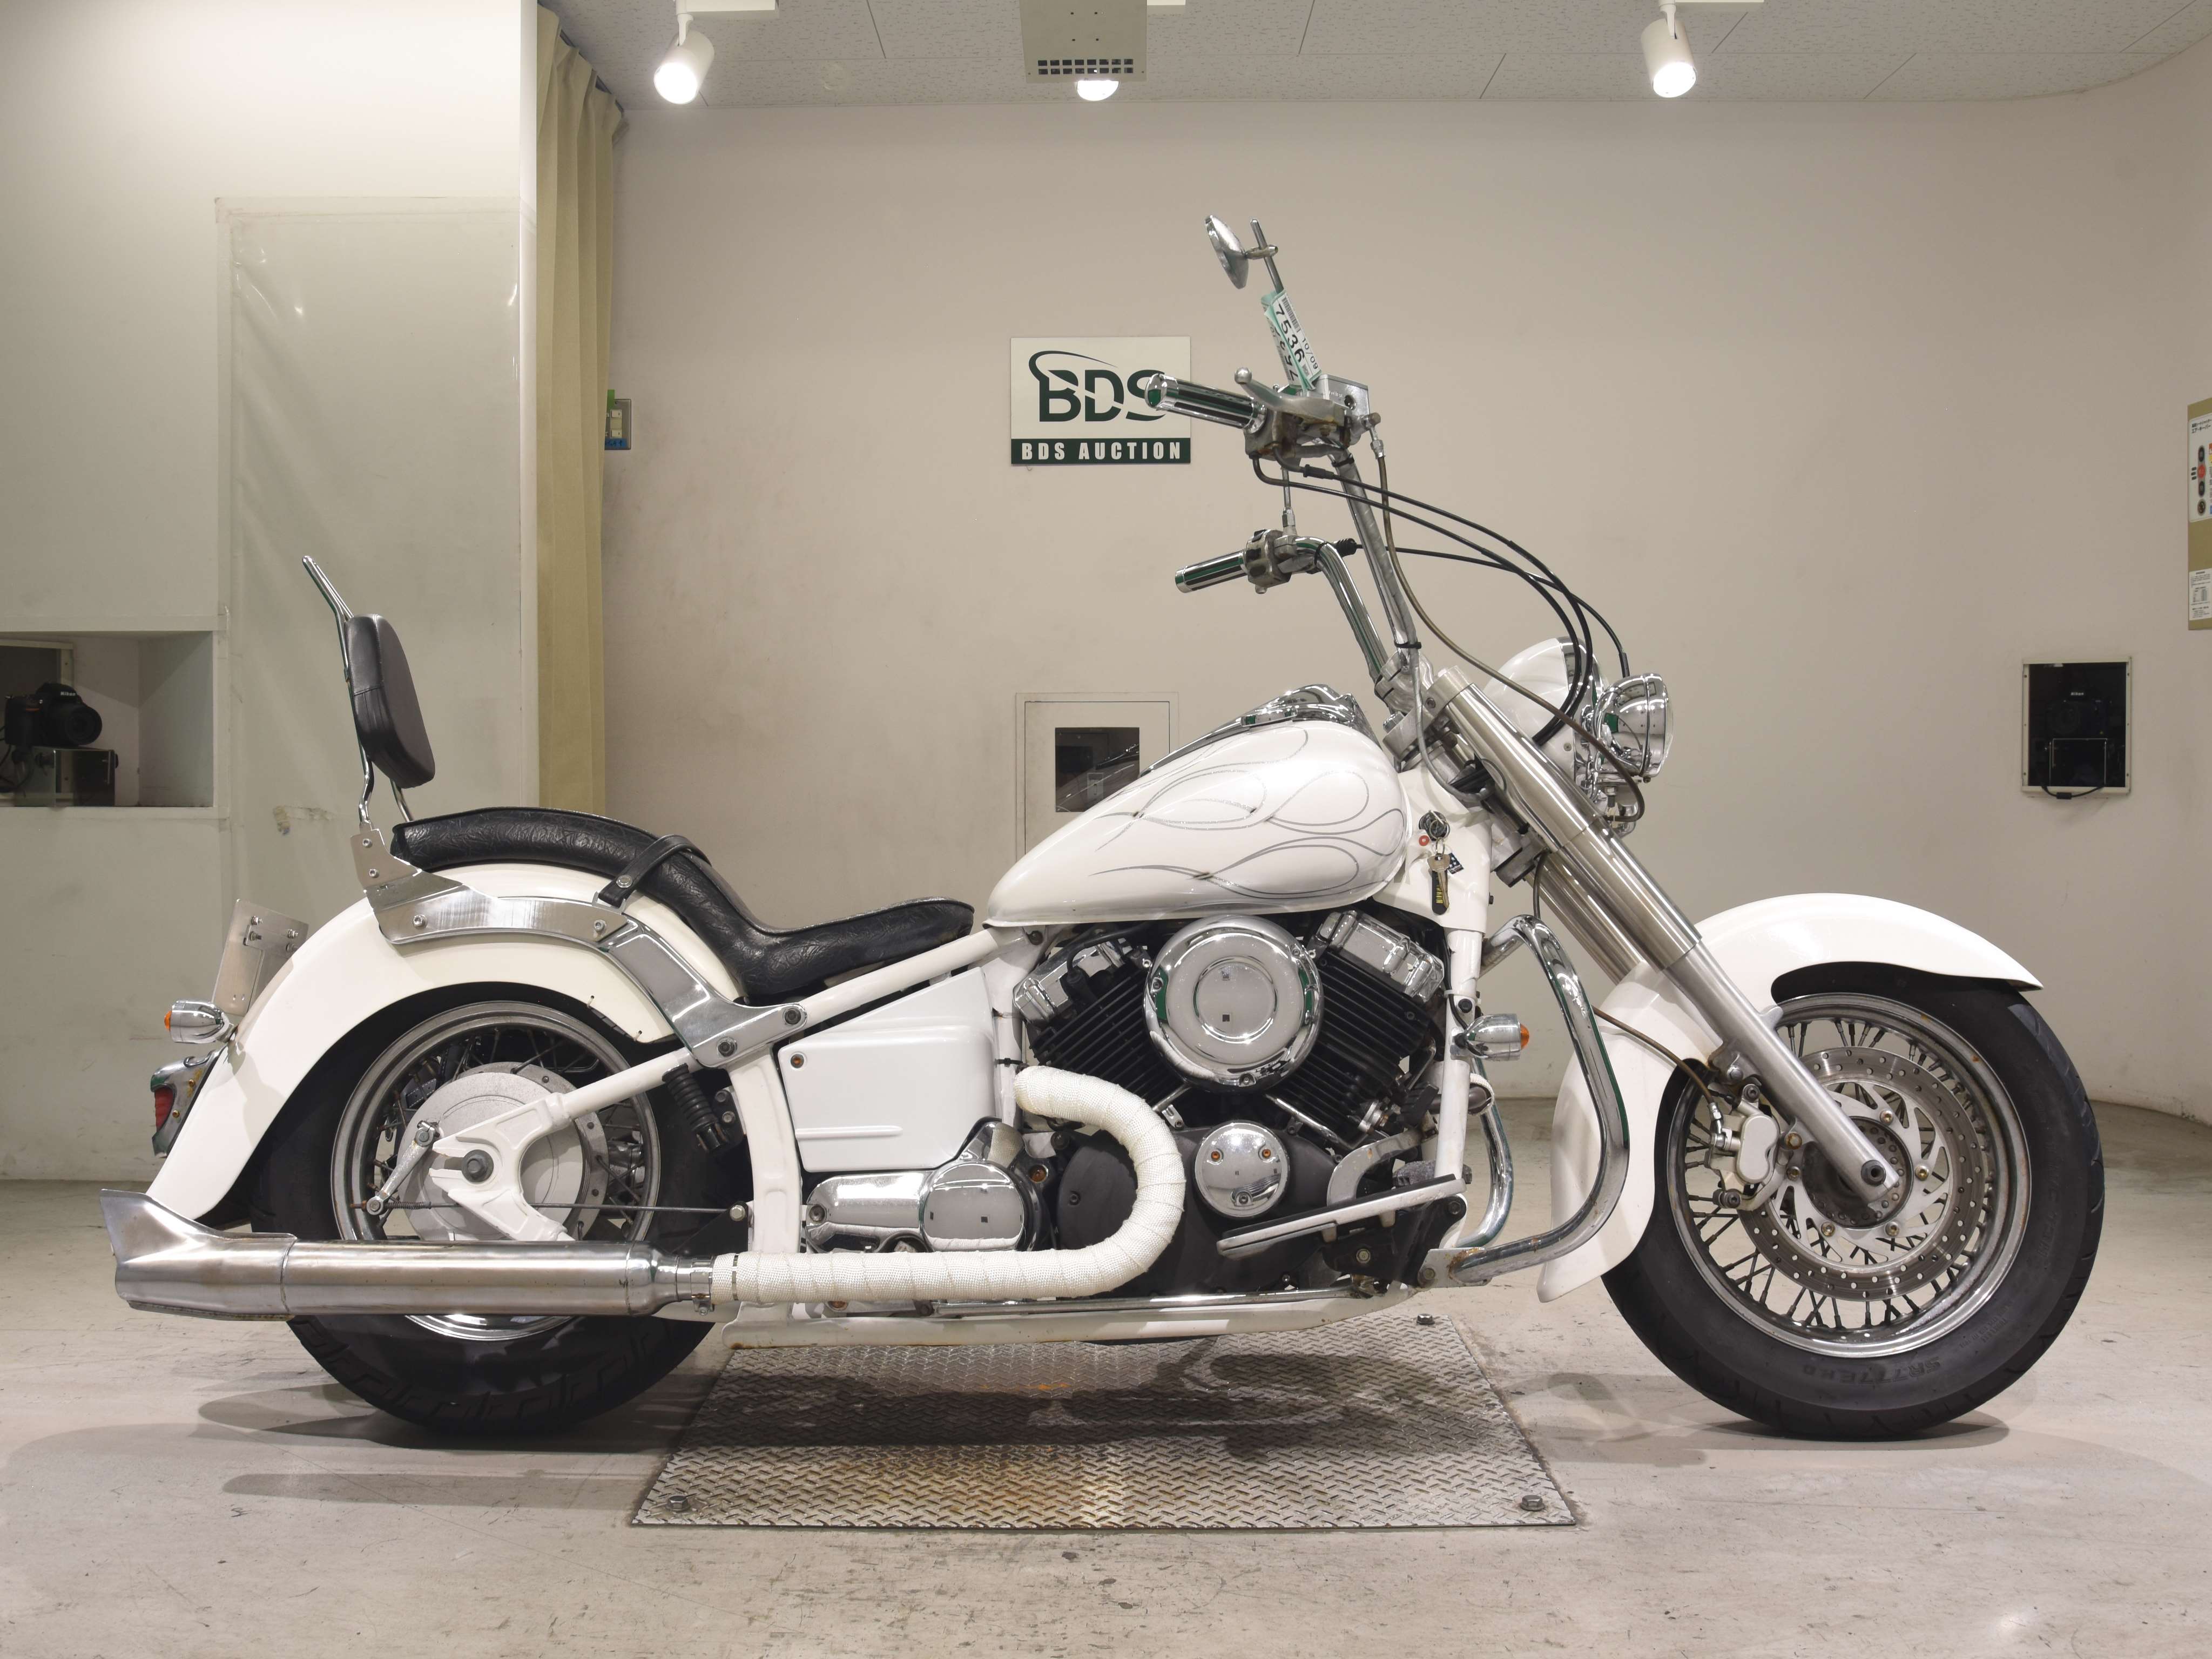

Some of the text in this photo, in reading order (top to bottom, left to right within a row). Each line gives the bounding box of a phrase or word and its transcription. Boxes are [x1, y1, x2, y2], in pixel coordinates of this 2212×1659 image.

[1276, 304, 1305, 363] 7536
[1302, 338, 1318, 369] 10/09
[1029, 350, 1166, 422] BDS
[1022, 442, 1181, 460] BDS AUCTION
